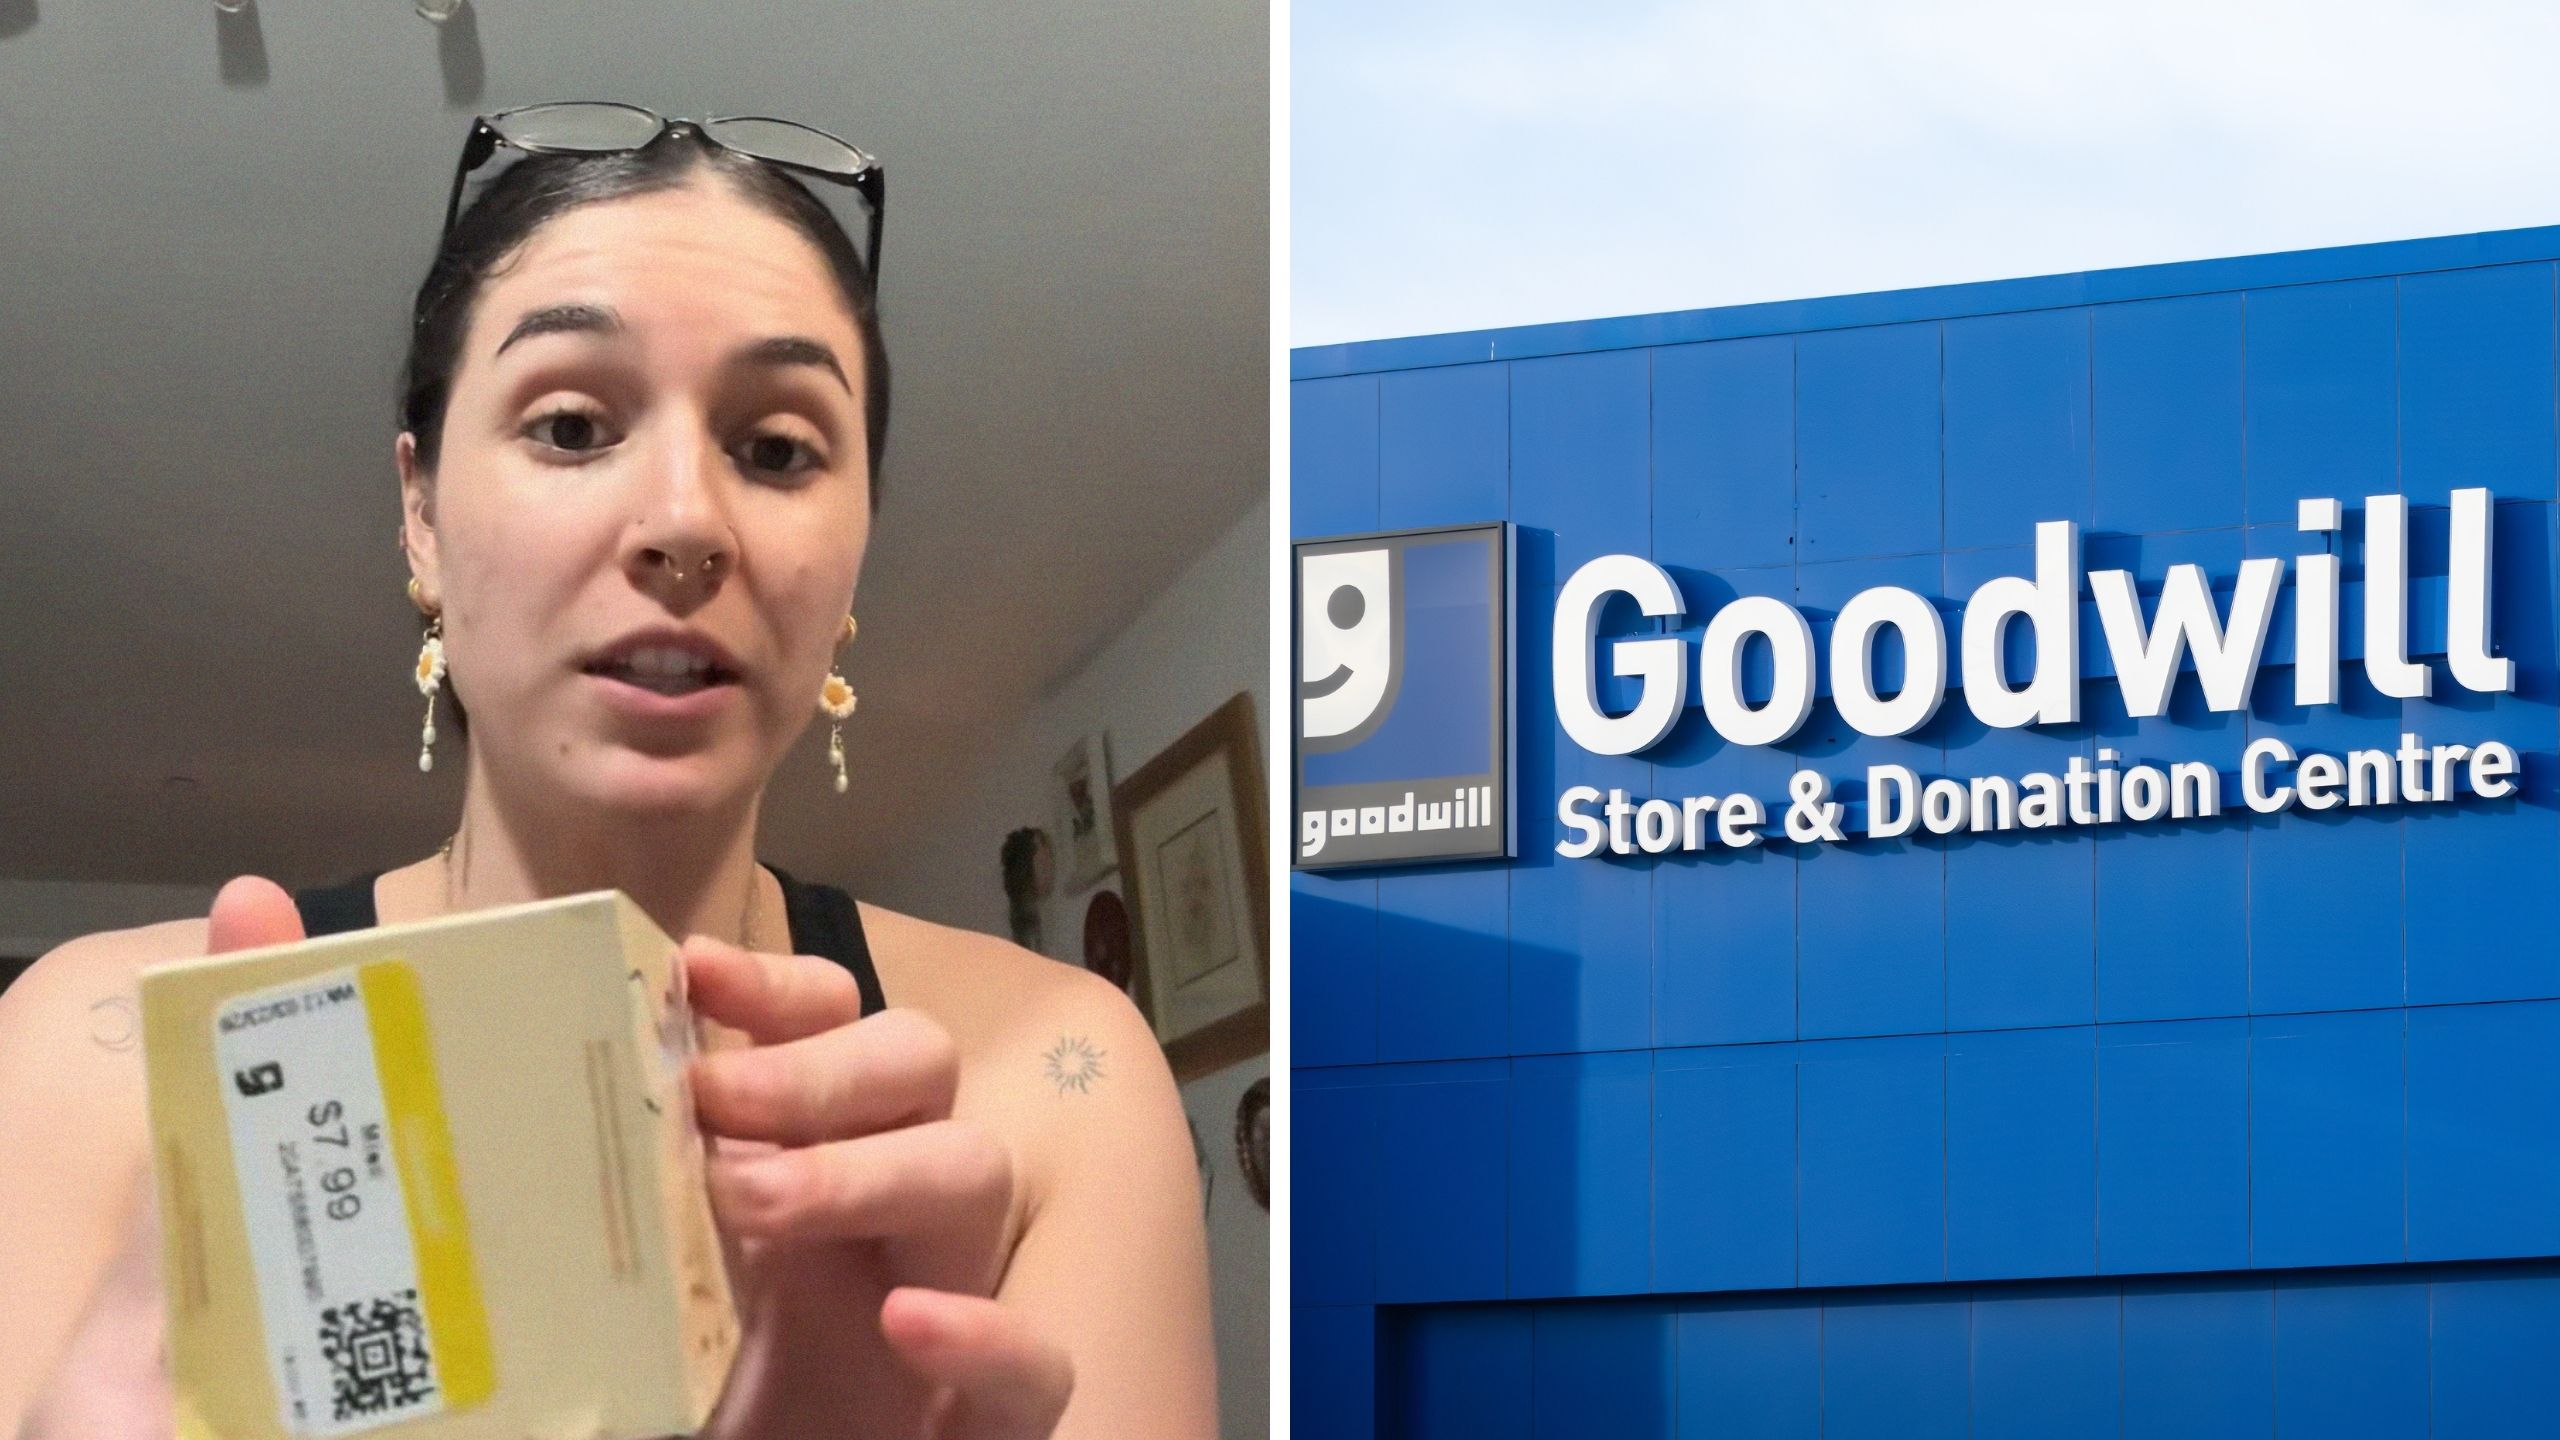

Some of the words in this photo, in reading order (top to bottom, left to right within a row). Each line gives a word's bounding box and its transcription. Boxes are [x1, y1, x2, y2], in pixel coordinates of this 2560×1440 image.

[1553, 487, 2515, 755] Goodwill
[1302, 786, 1491, 858] goodwill
[1555, 785, 1766, 859] Store
[1784, 769, 1848, 843] &
[1867, 748, 2220, 838] Donation
[2241, 732, 2522, 812] Centre
